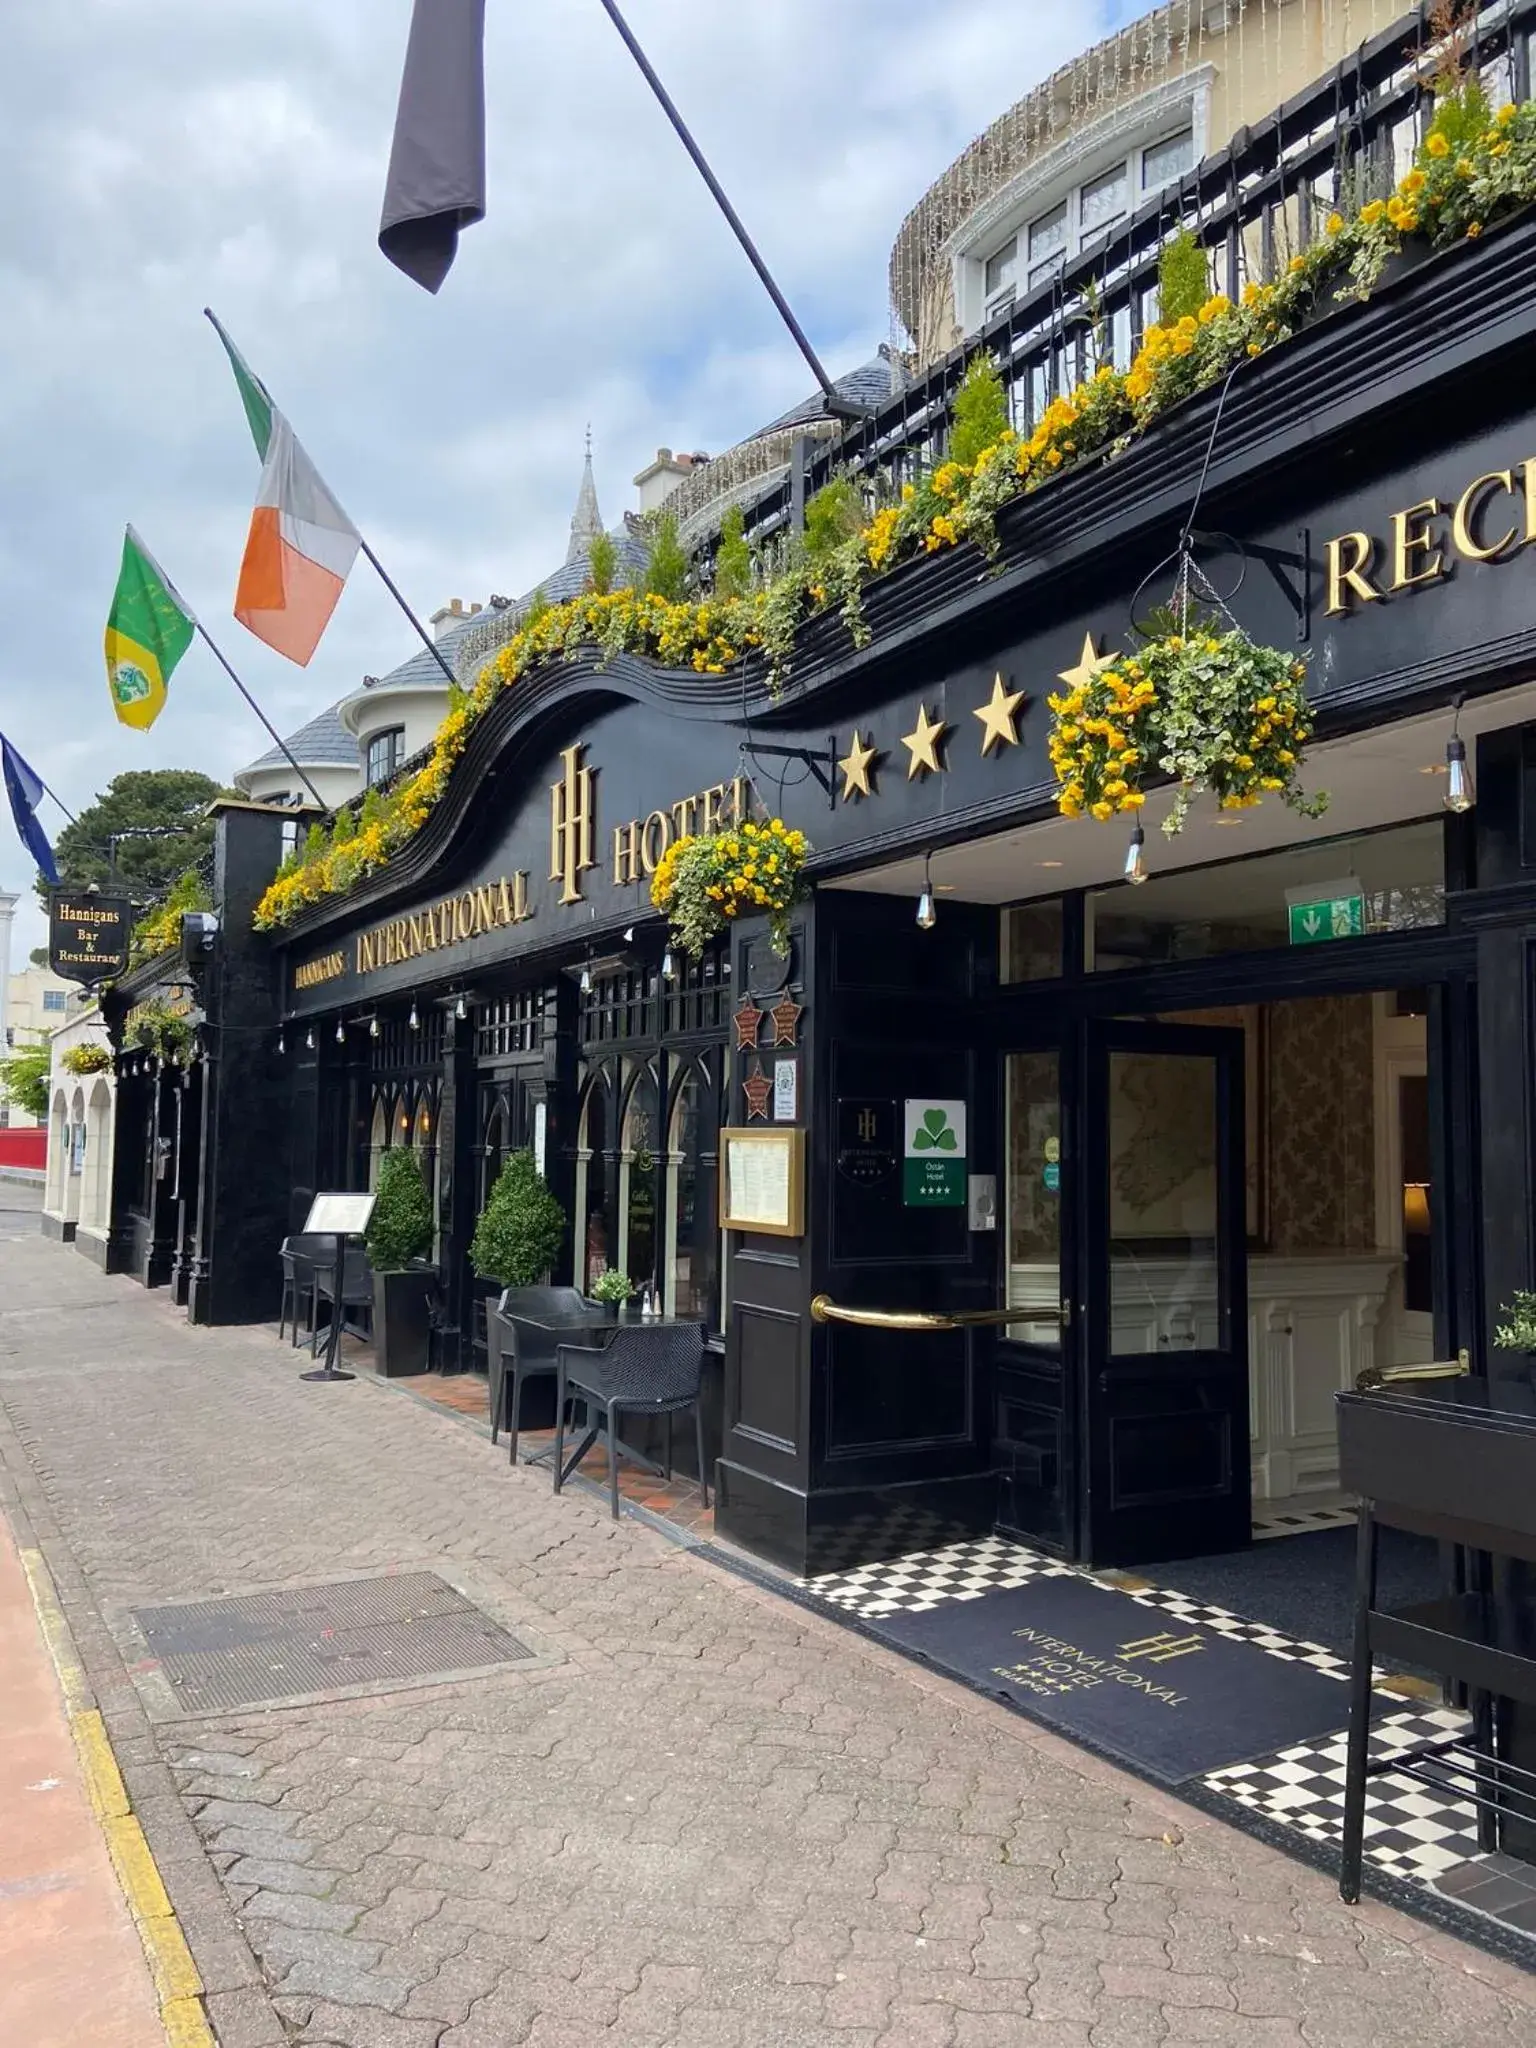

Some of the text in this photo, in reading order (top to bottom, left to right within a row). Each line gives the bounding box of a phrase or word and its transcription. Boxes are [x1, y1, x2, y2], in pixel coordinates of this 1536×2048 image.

[59, 903, 120, 927] Hannigans
[356, 868, 529, 974] INTERNATIONAL
[77, 928, 99, 941] Bar
[85, 941, 96, 952] &
[58, 949, 121, 965] Restaurant
[1011, 1627, 1188, 1707] INTERNATIONAL
[1029, 1655, 1103, 1689] HOTEL
